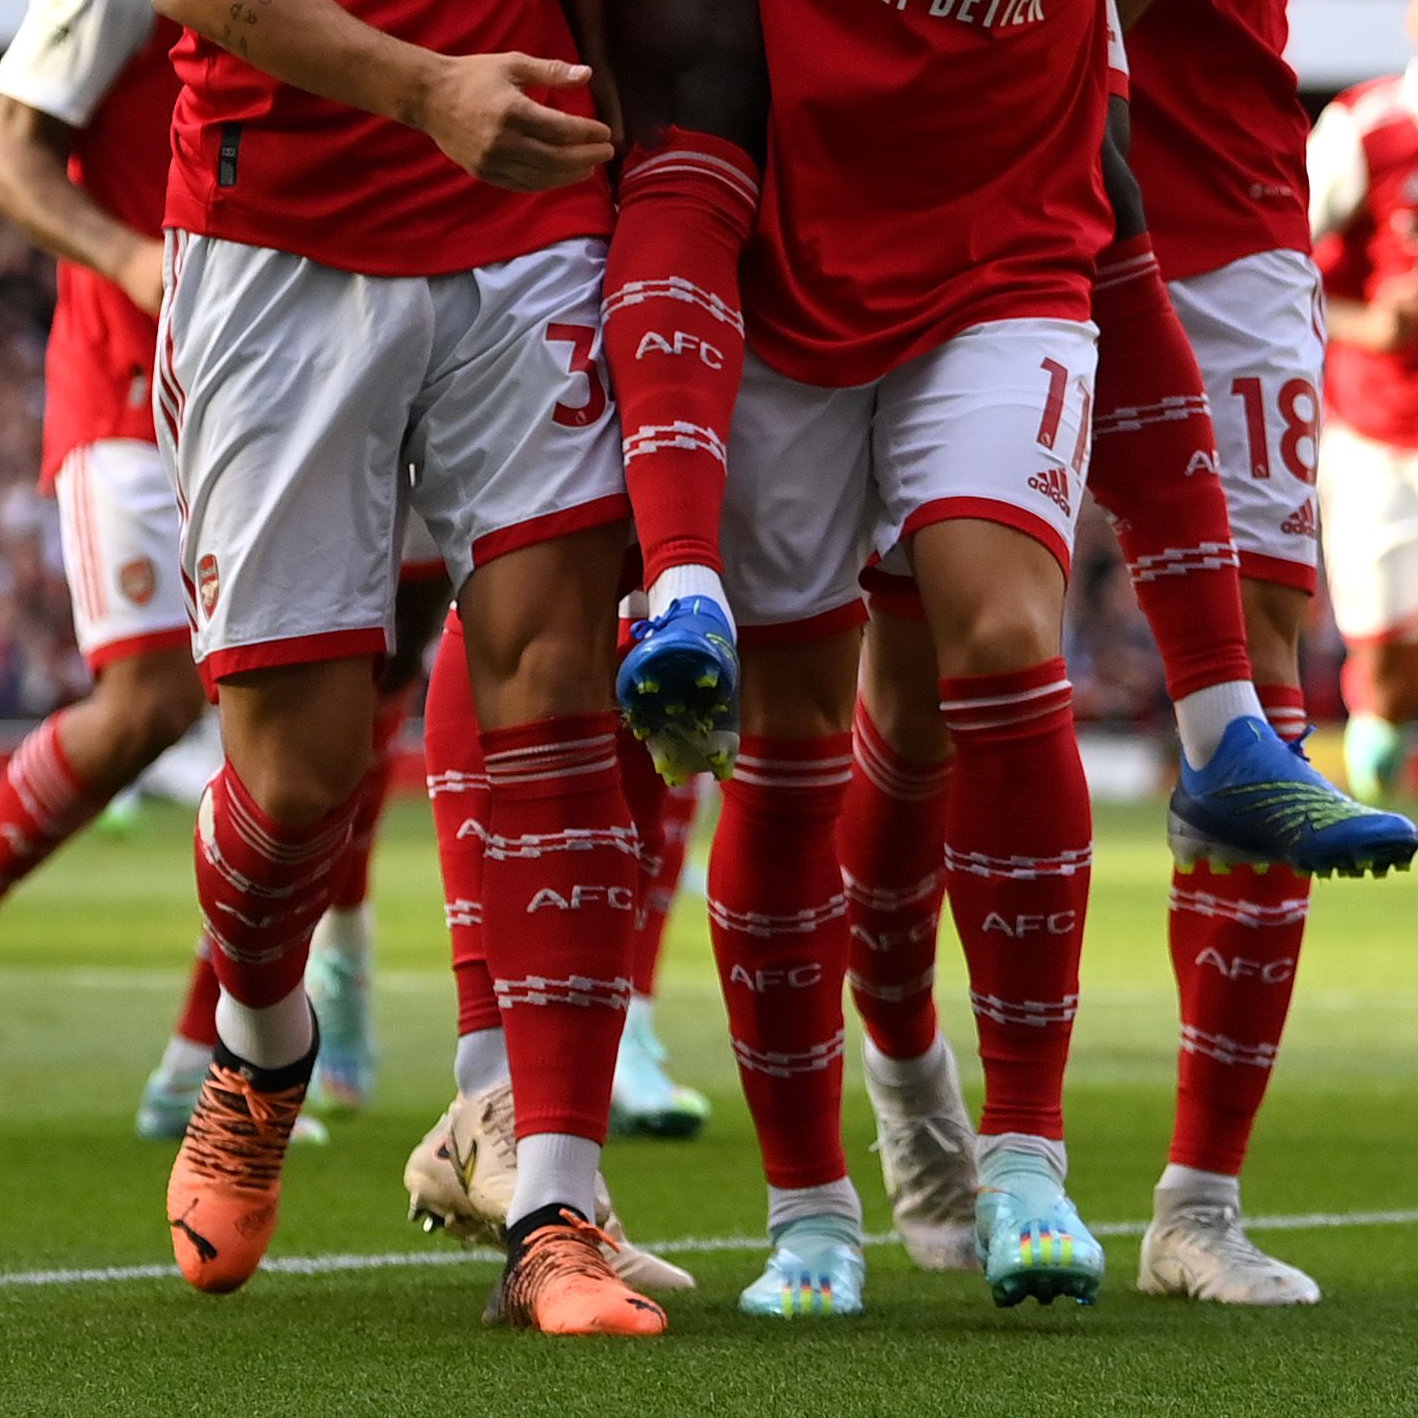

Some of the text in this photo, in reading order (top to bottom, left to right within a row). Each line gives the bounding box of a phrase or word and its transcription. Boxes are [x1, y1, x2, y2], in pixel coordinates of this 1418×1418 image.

[635, 330, 724, 370] AFC
[1231, 377, 1318, 482] 18
[526, 885, 633, 914] AFC
[982, 910, 1076, 938] AFC
[730, 961, 823, 993] AFC
[1195, 946, 1293, 982] AFC
